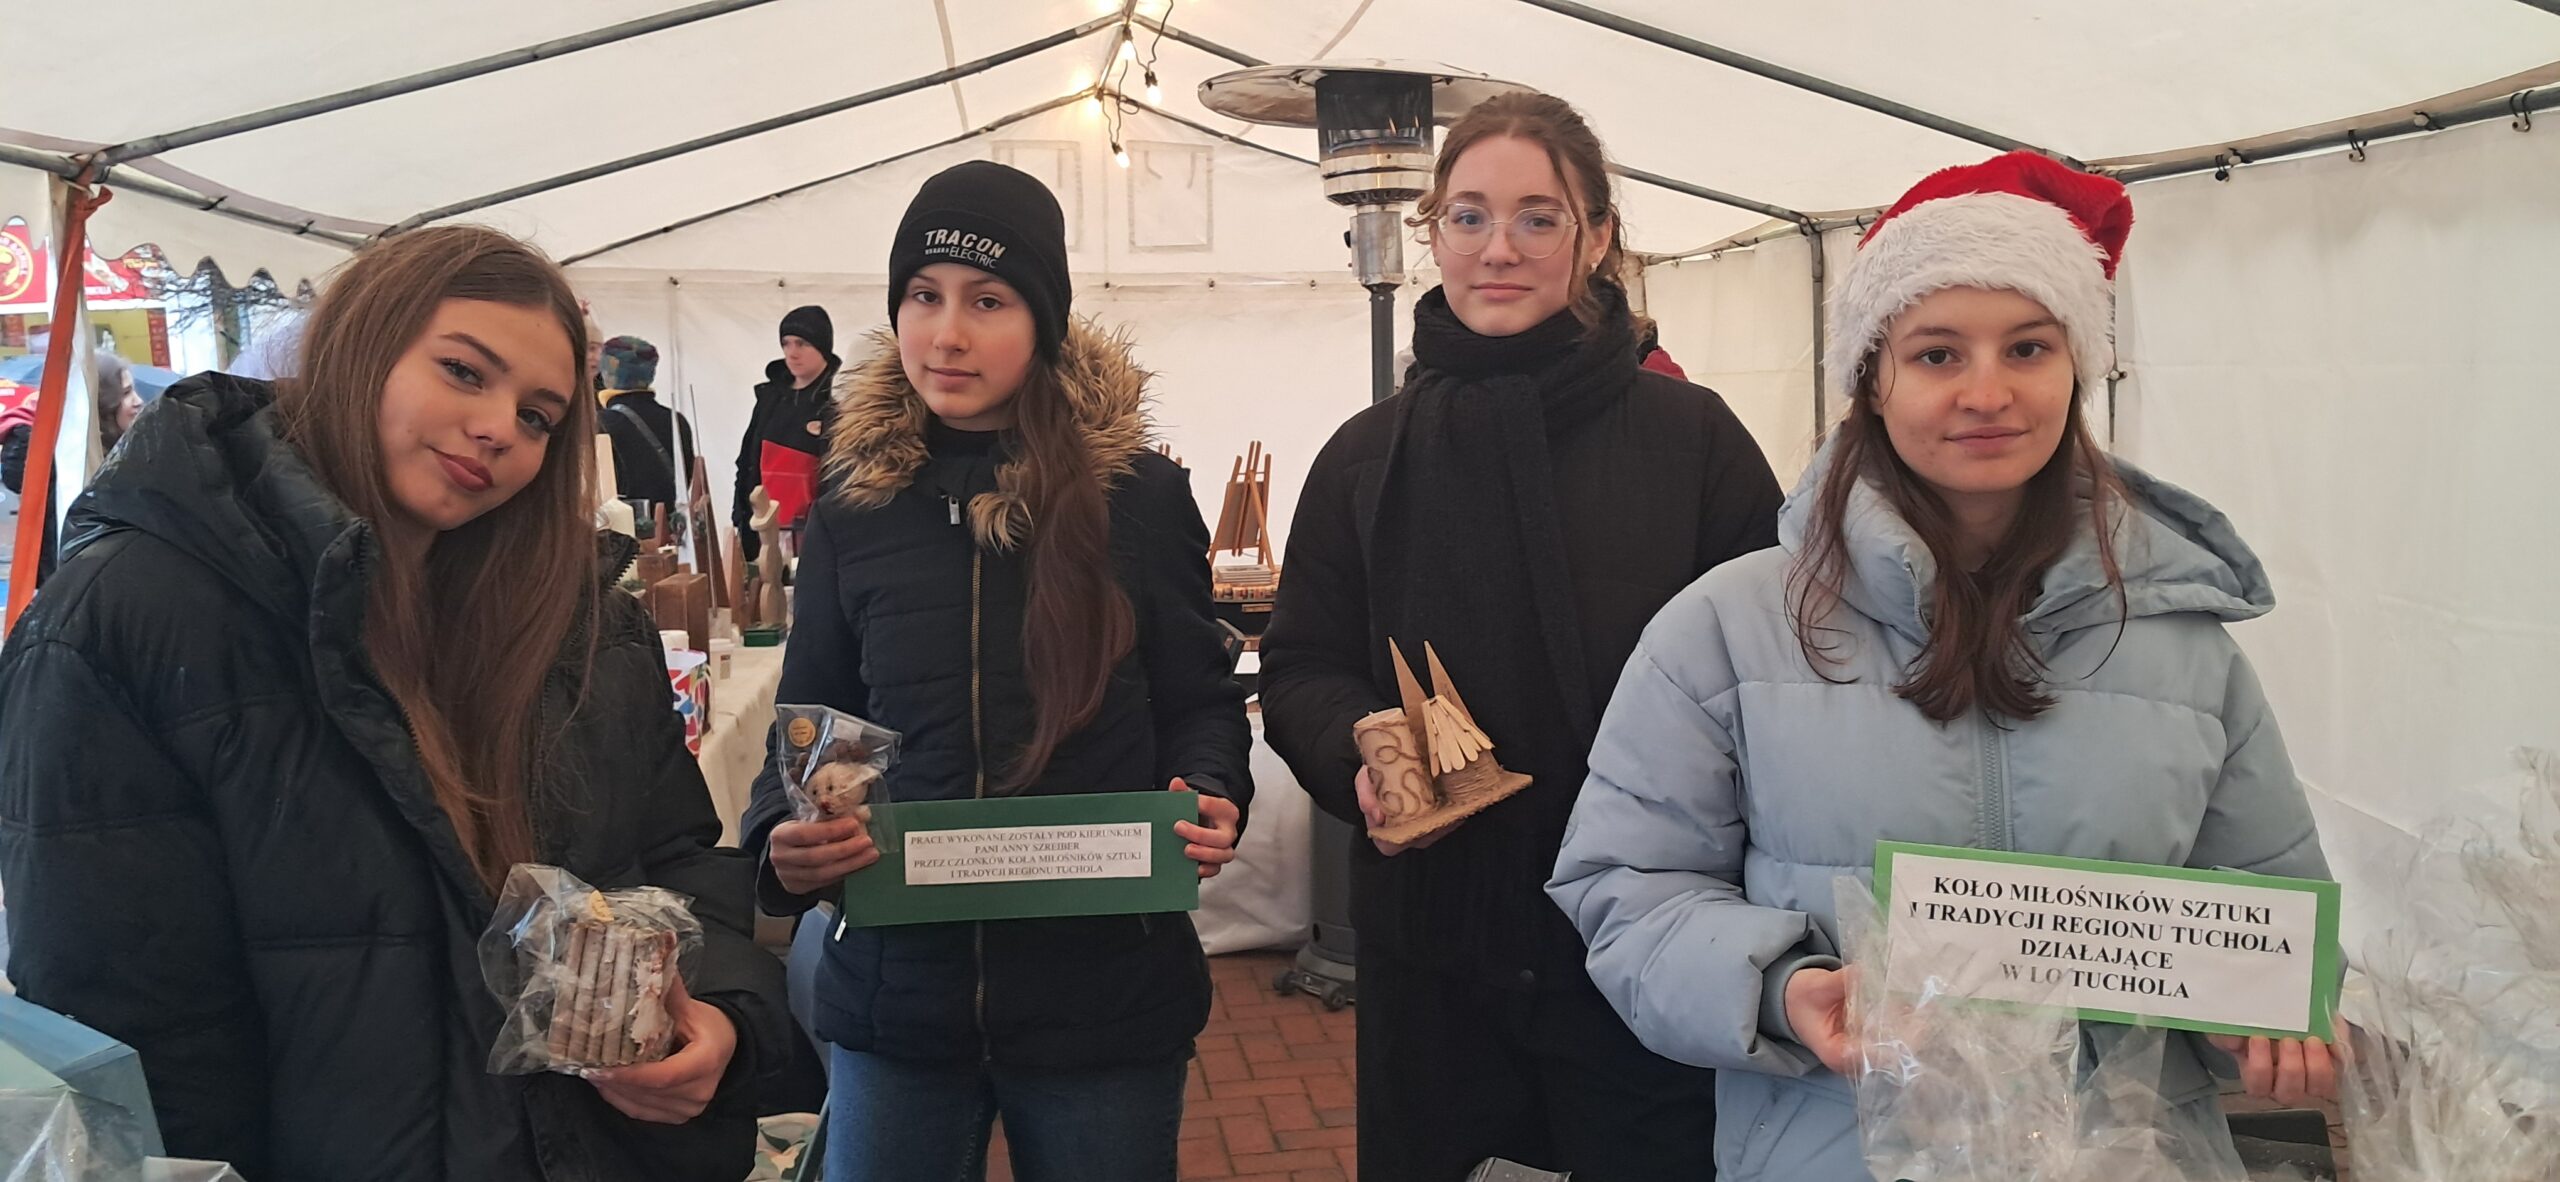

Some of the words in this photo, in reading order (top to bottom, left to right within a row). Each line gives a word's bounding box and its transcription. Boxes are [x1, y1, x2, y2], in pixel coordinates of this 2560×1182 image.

[925, 229, 1006, 258] TRACON
[949, 246, 997, 268] ELECTRIC
[911, 835, 944, 845] PRACE
[947, 833, 1006, 843] WYKONANE
[1057, 830, 1077, 839] POD
[1080, 829, 1142, 838] KIERUNKIEM
[975, 846, 999, 854] PANI
[1000, 844, 1031, 853] ANNY
[1033, 842, 1080, 851] SZREIBER
[914, 859, 945, 868] PRZEZ
[1106, 851, 1141, 861] SZTUKI
[957, 868, 1006, 878] TRADYCJI
[1008, 866, 1053, 876] REGIONU
[1055, 865, 1103, 874] TUCHOLA
[1934, 876, 2003, 899] KOŁO
[2010, 883, 2175, 916] MIŁOŚNIKÓW
[2180, 899, 2271, 925] SZTUKI
[1925, 902, 2044, 931] TRADYCJI
[2052, 914, 2163, 942] REGIONU
[2171, 926, 2292, 955] TUCHOLA
[2021, 938, 2173, 970] DZIAŁAJĄCE
[2000, 961, 2024, 981] W
[2030, 966, 2062, 985] LO
[2072, 970, 2190, 999] TUCHOLA
